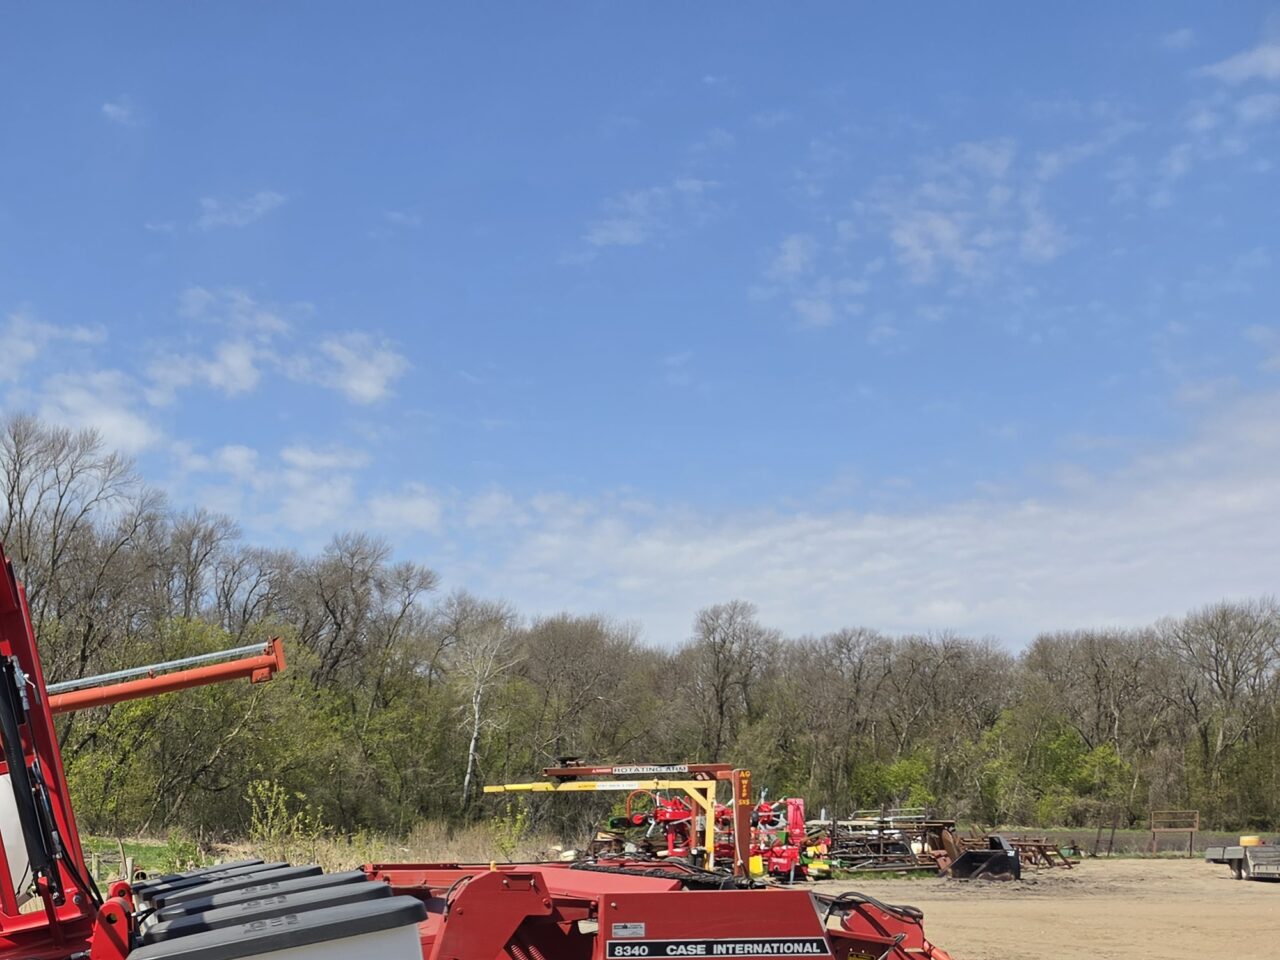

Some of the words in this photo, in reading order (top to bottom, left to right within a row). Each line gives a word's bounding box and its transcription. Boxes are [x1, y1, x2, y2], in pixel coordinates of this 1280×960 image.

[614, 945, 649, 957] 8340
[666, 944, 707, 956] CASE
[712, 942, 821, 955] INTERNATIONAL
